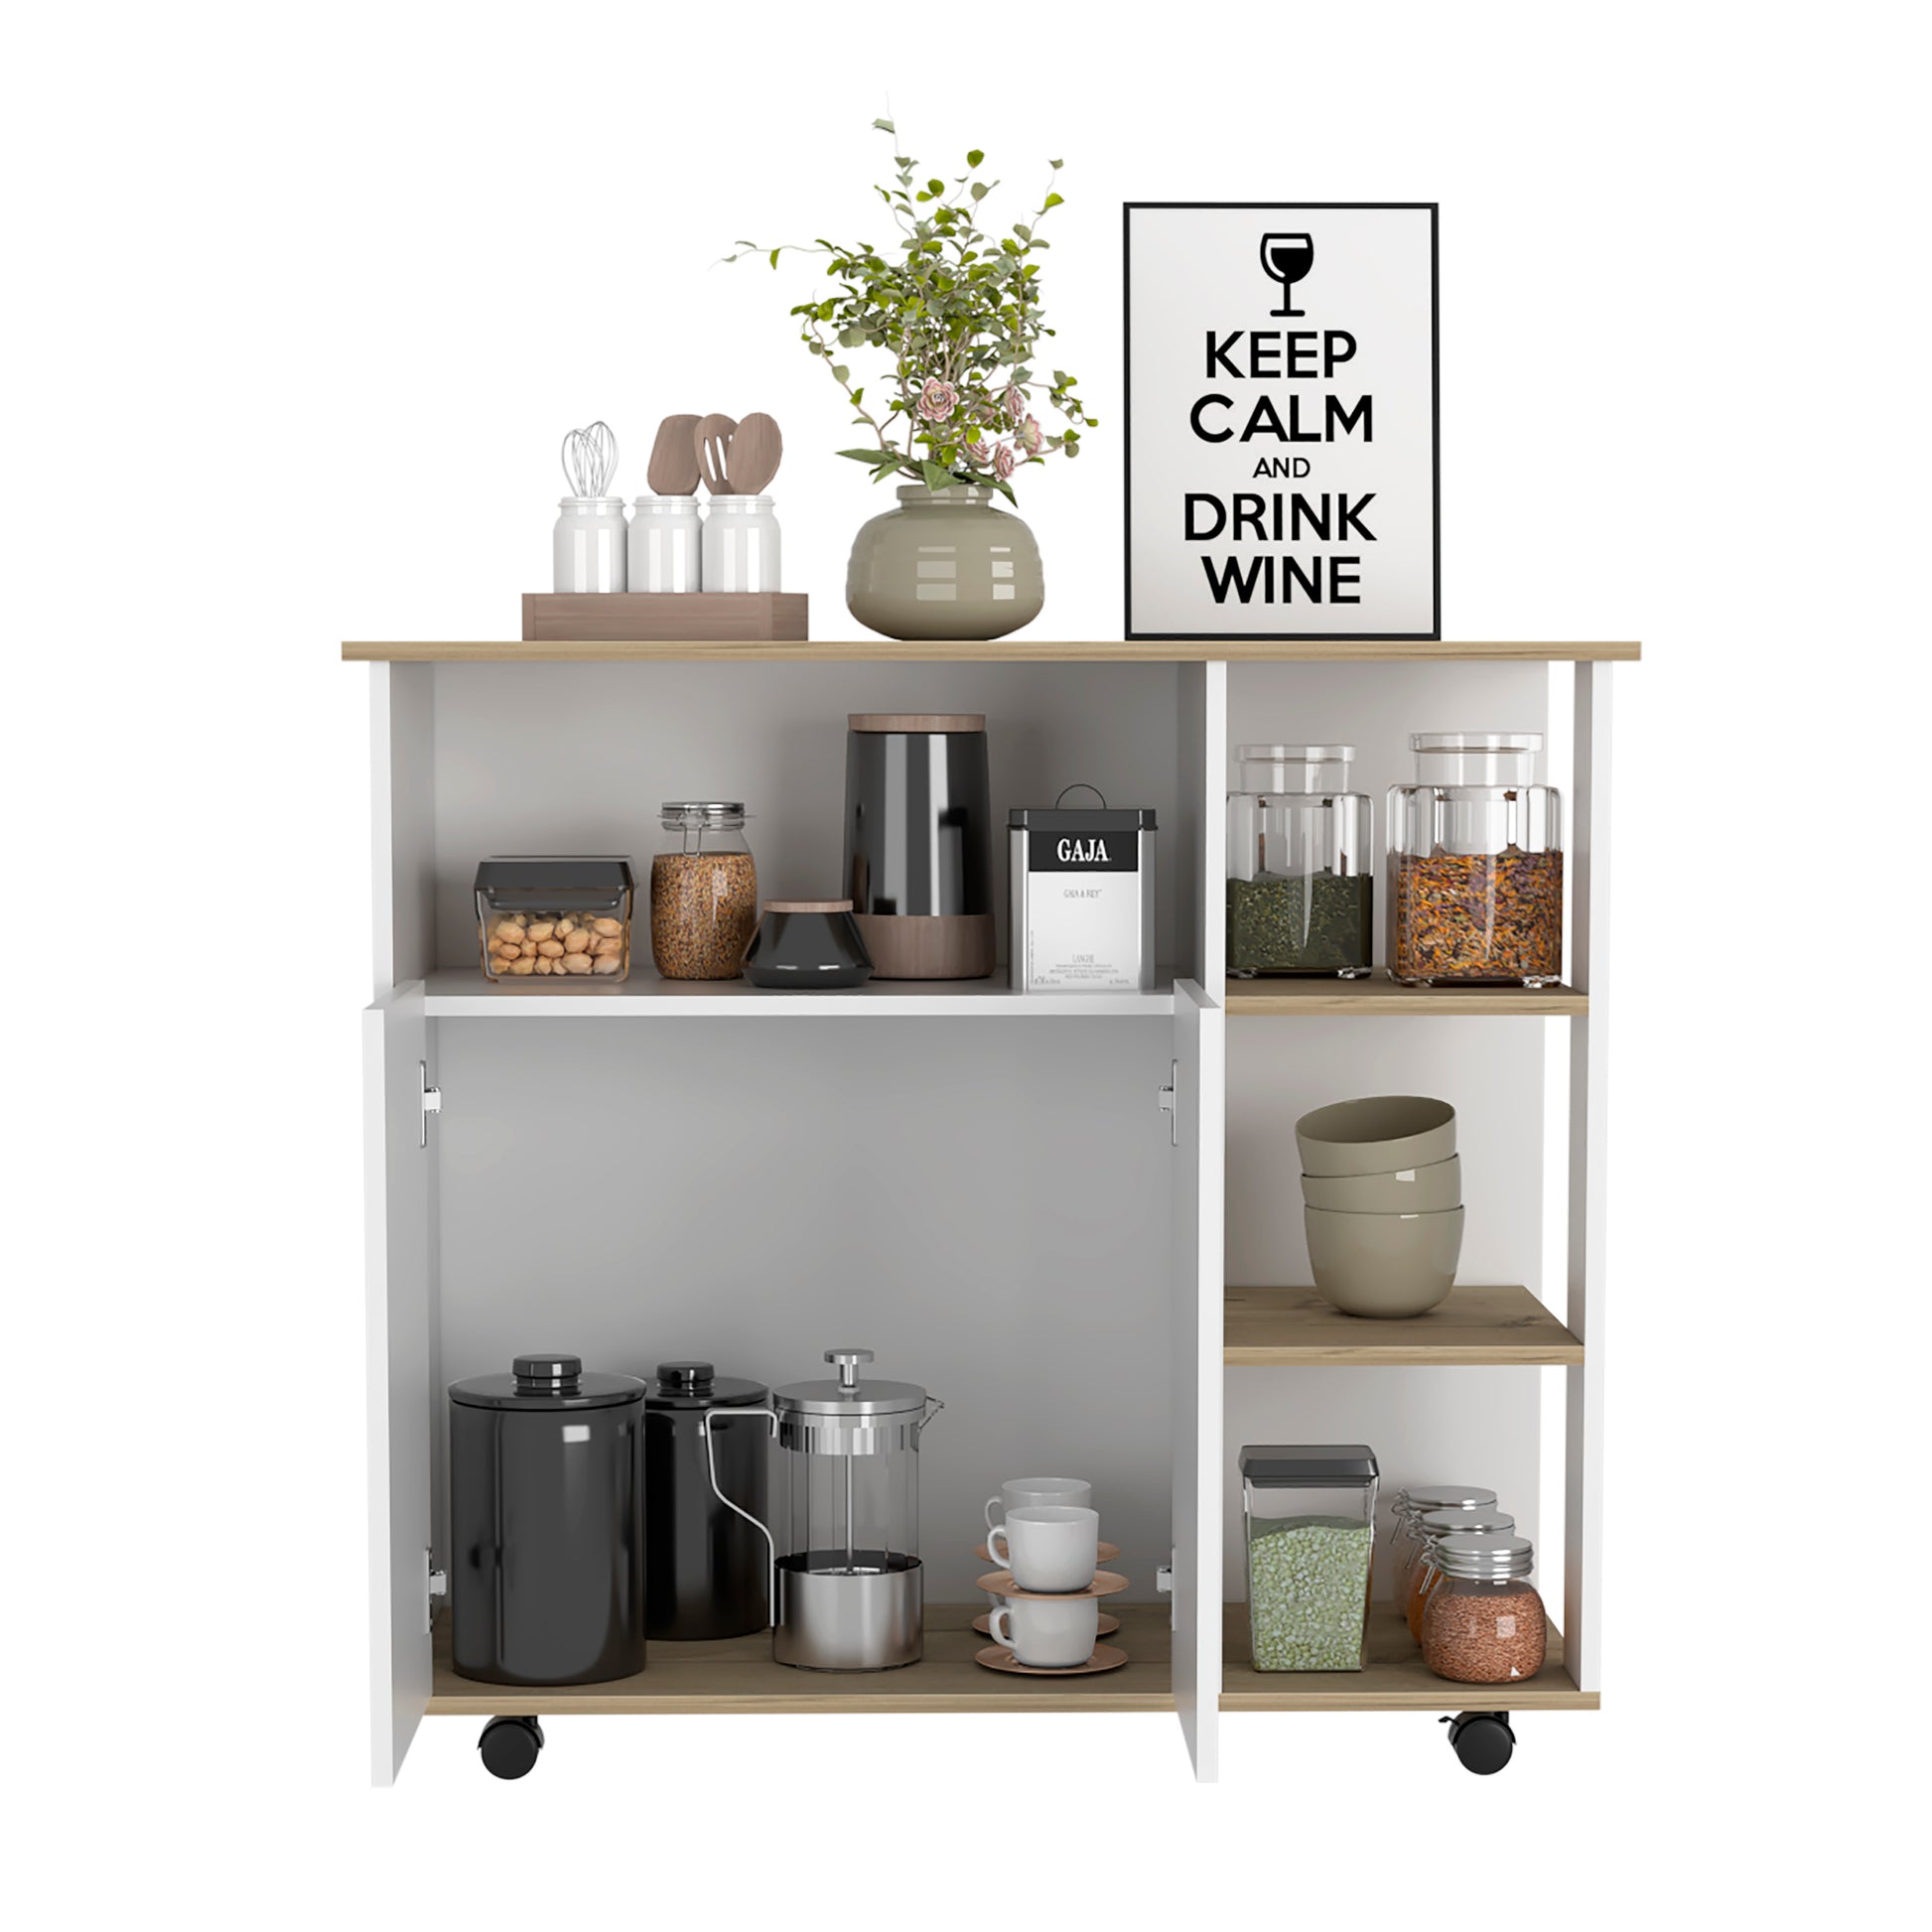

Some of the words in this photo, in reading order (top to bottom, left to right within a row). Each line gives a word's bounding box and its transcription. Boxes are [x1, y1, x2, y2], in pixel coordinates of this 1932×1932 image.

[1206, 330, 1357, 378] KEEP
[1190, 393, 1373, 444] CALM
[1252, 457, 1311, 479] AND
[1184, 492, 1378, 541] DRINK
[1200, 556, 1361, 605] WINE
[1056, 838, 1110, 862] GAJA
